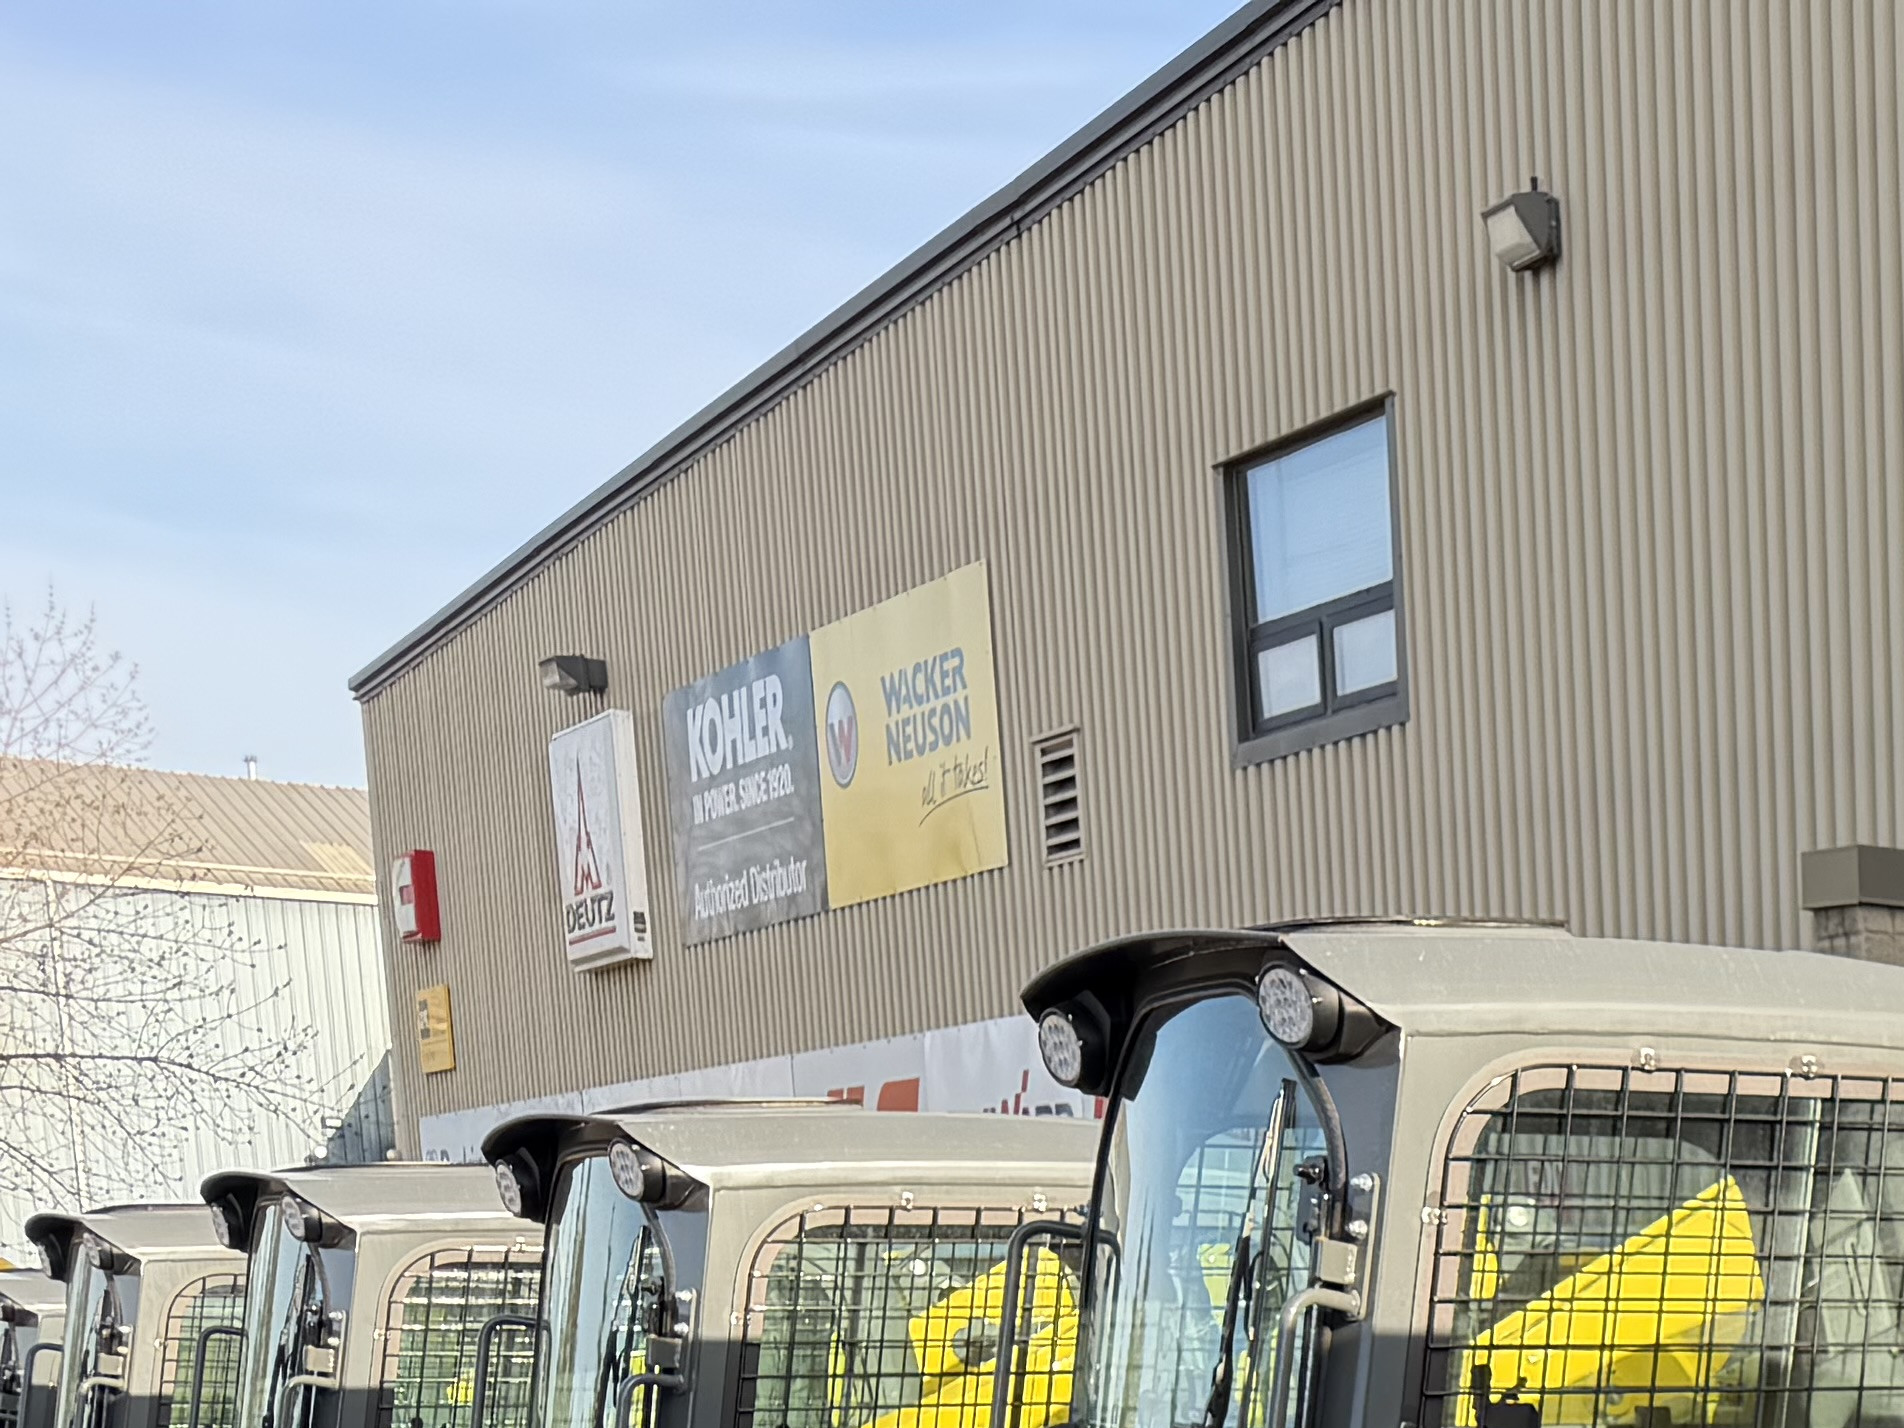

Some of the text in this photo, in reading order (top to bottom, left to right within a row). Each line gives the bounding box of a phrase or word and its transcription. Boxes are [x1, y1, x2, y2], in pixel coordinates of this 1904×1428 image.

[879, 646, 968, 718] WACKER
[885, 694, 972, 766] NEUSON
[738, 771, 769, 811] SINCE
[565, 890, 616, 935] DEUTZ
[694, 855, 808, 921] Authorized Distributor
